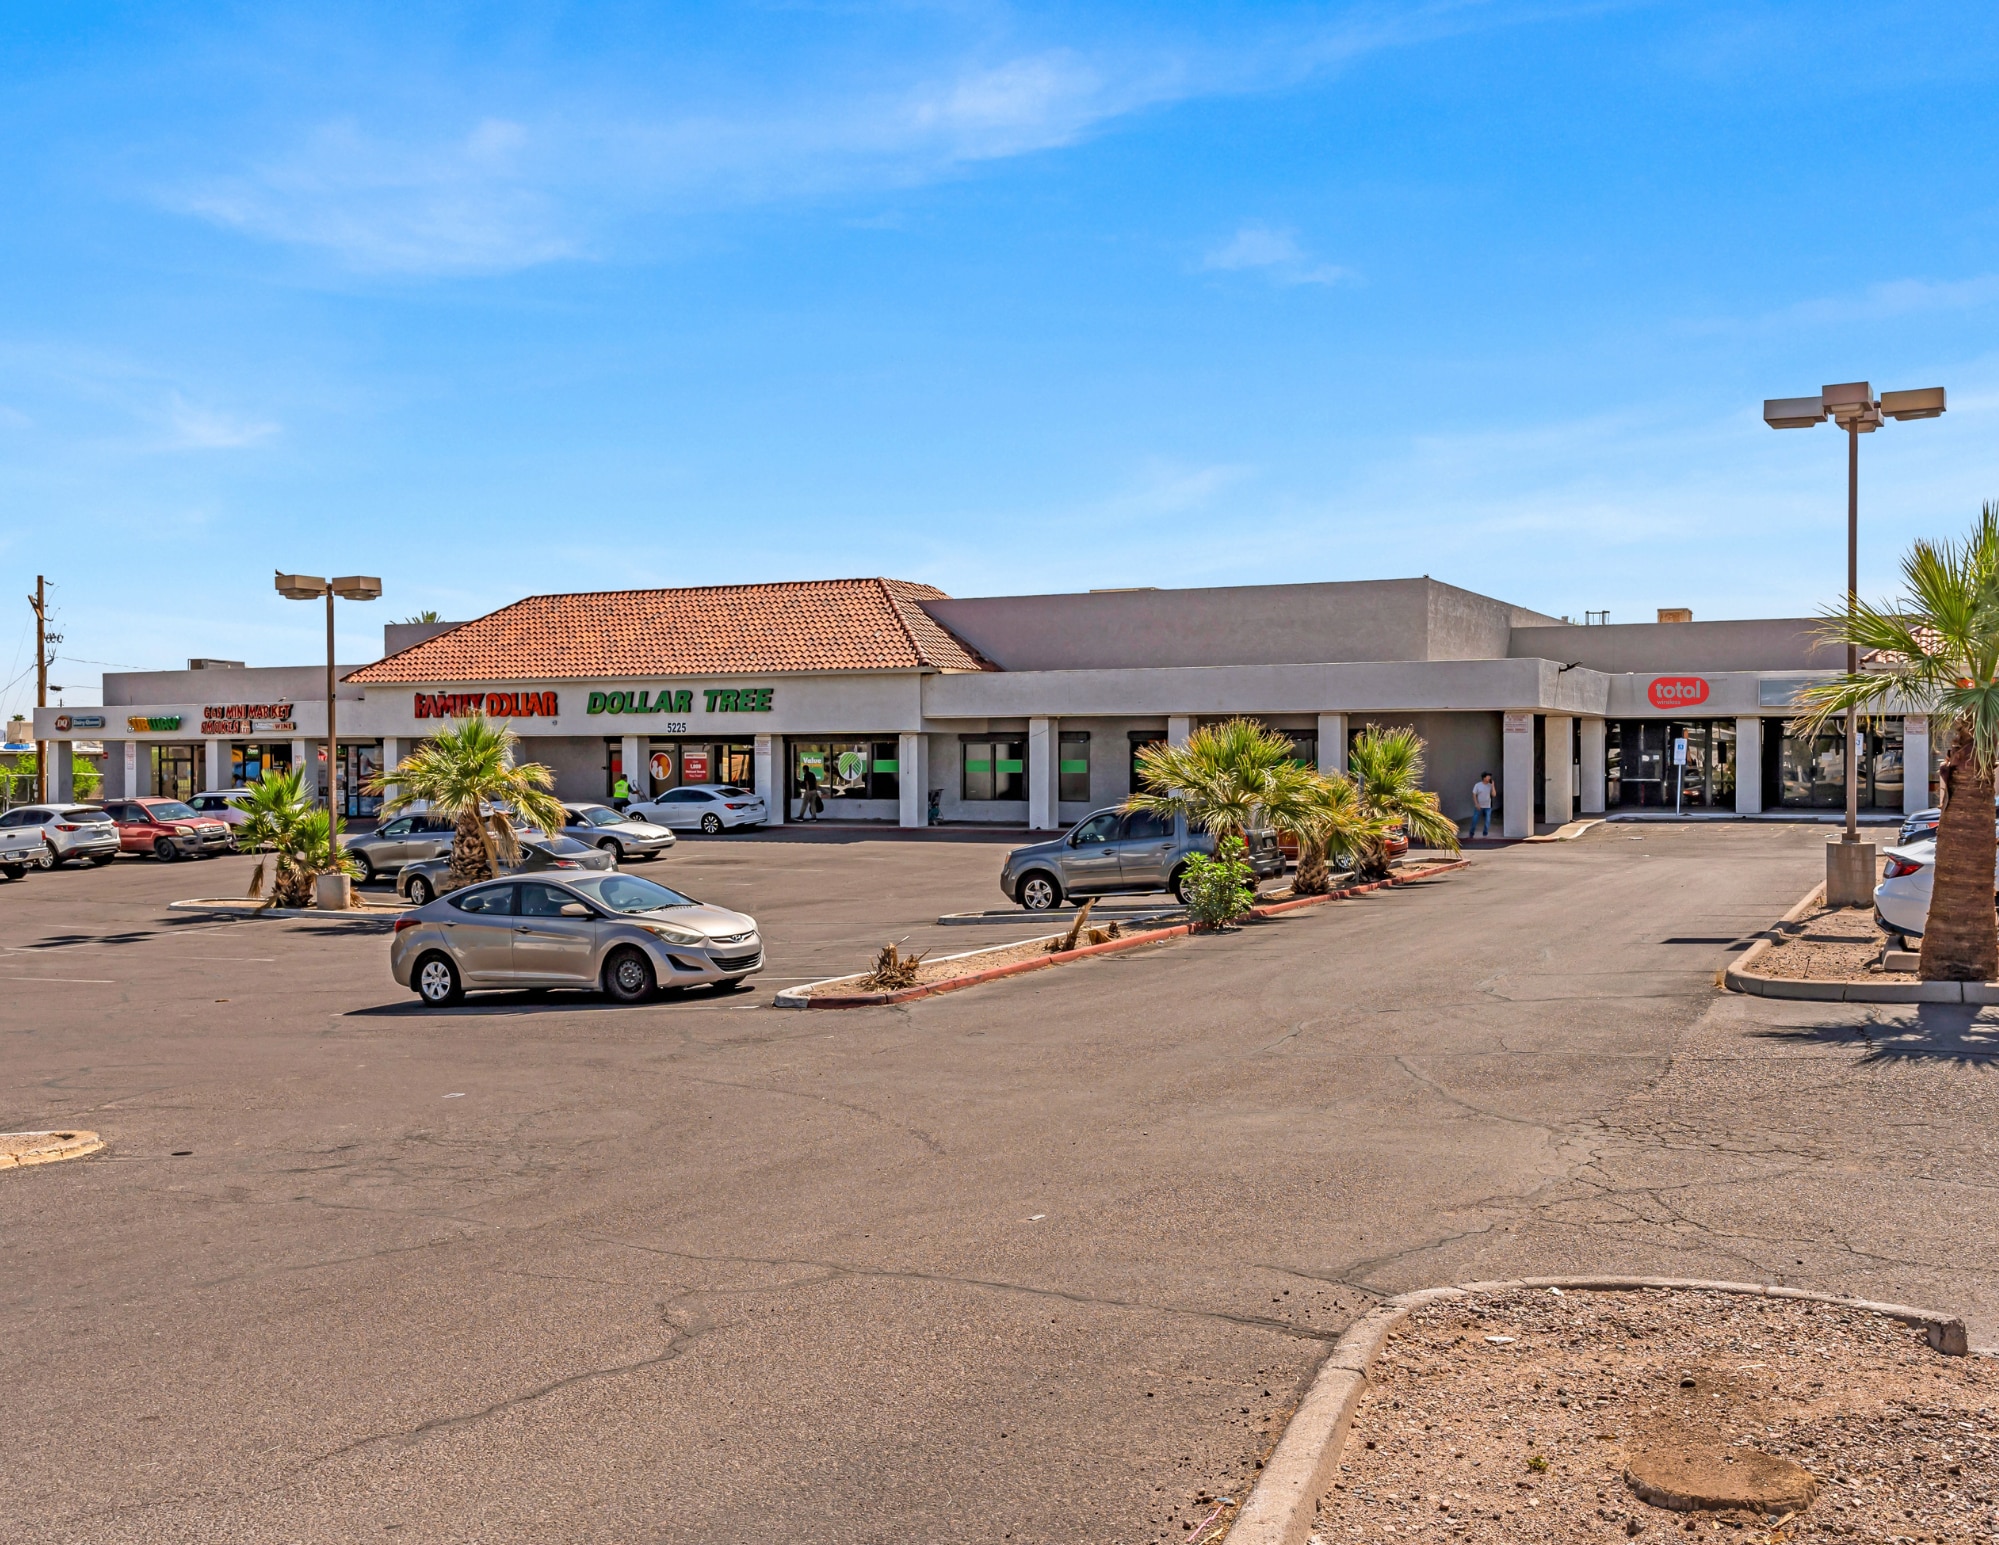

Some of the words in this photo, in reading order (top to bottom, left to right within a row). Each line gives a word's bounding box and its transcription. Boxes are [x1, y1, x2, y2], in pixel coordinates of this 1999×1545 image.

[1656, 680, 1701, 699] total
[414, 692, 485, 718] FAMILY
[485, 690, 558, 717] DOLLAR
[586, 689, 694, 715] DOLLAR
[703, 688, 775, 713] TREE
[226, 704, 247, 719] MINI
[248, 704, 292, 719] MARKET
[57, 719, 68, 727] DQ
[127, 715, 181, 732] SUBWAY
[201, 720, 239, 734] SMOKES
[667, 722, 687, 733] 5225
